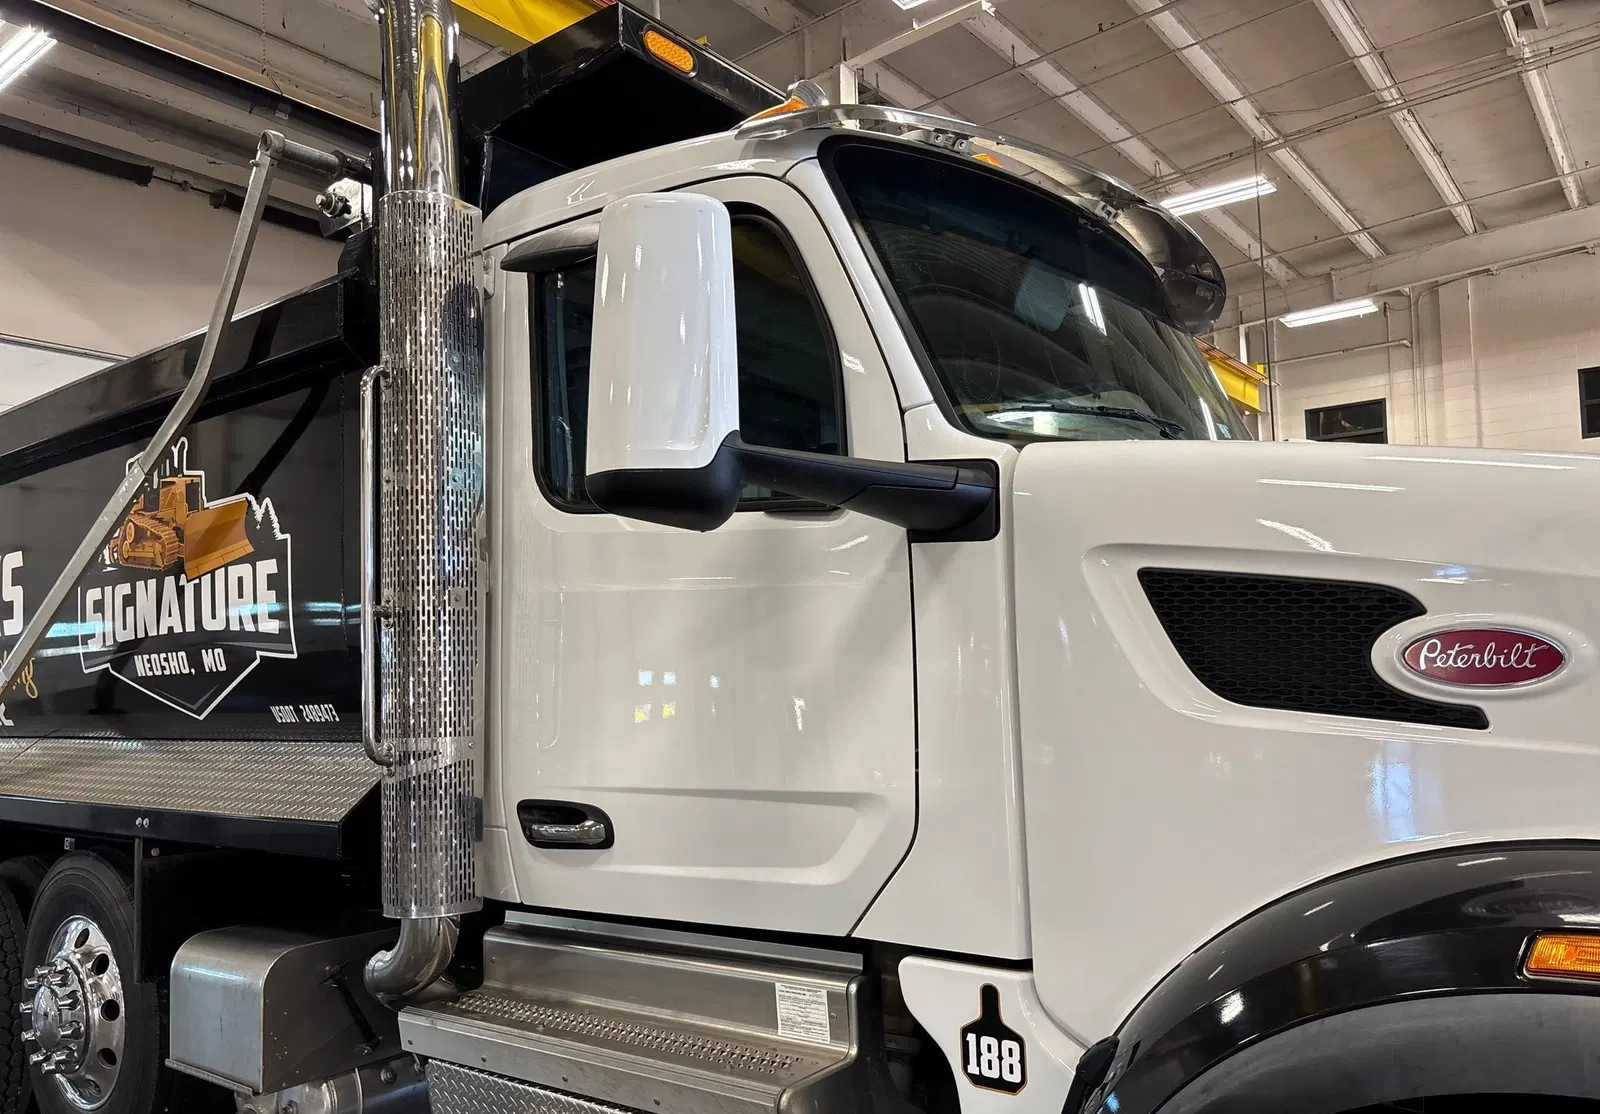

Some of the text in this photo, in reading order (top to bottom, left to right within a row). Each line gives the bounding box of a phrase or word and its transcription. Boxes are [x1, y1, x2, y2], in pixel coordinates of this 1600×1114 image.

[85, 558, 280, 652] SIGNATURE
[134, 648, 227, 677] NEOSHO, MO
[1419, 639, 1550, 670] Peterbilt
[269, 703, 340, 723] USDOT 2489473
[965, 1032, 1022, 1084] 188
